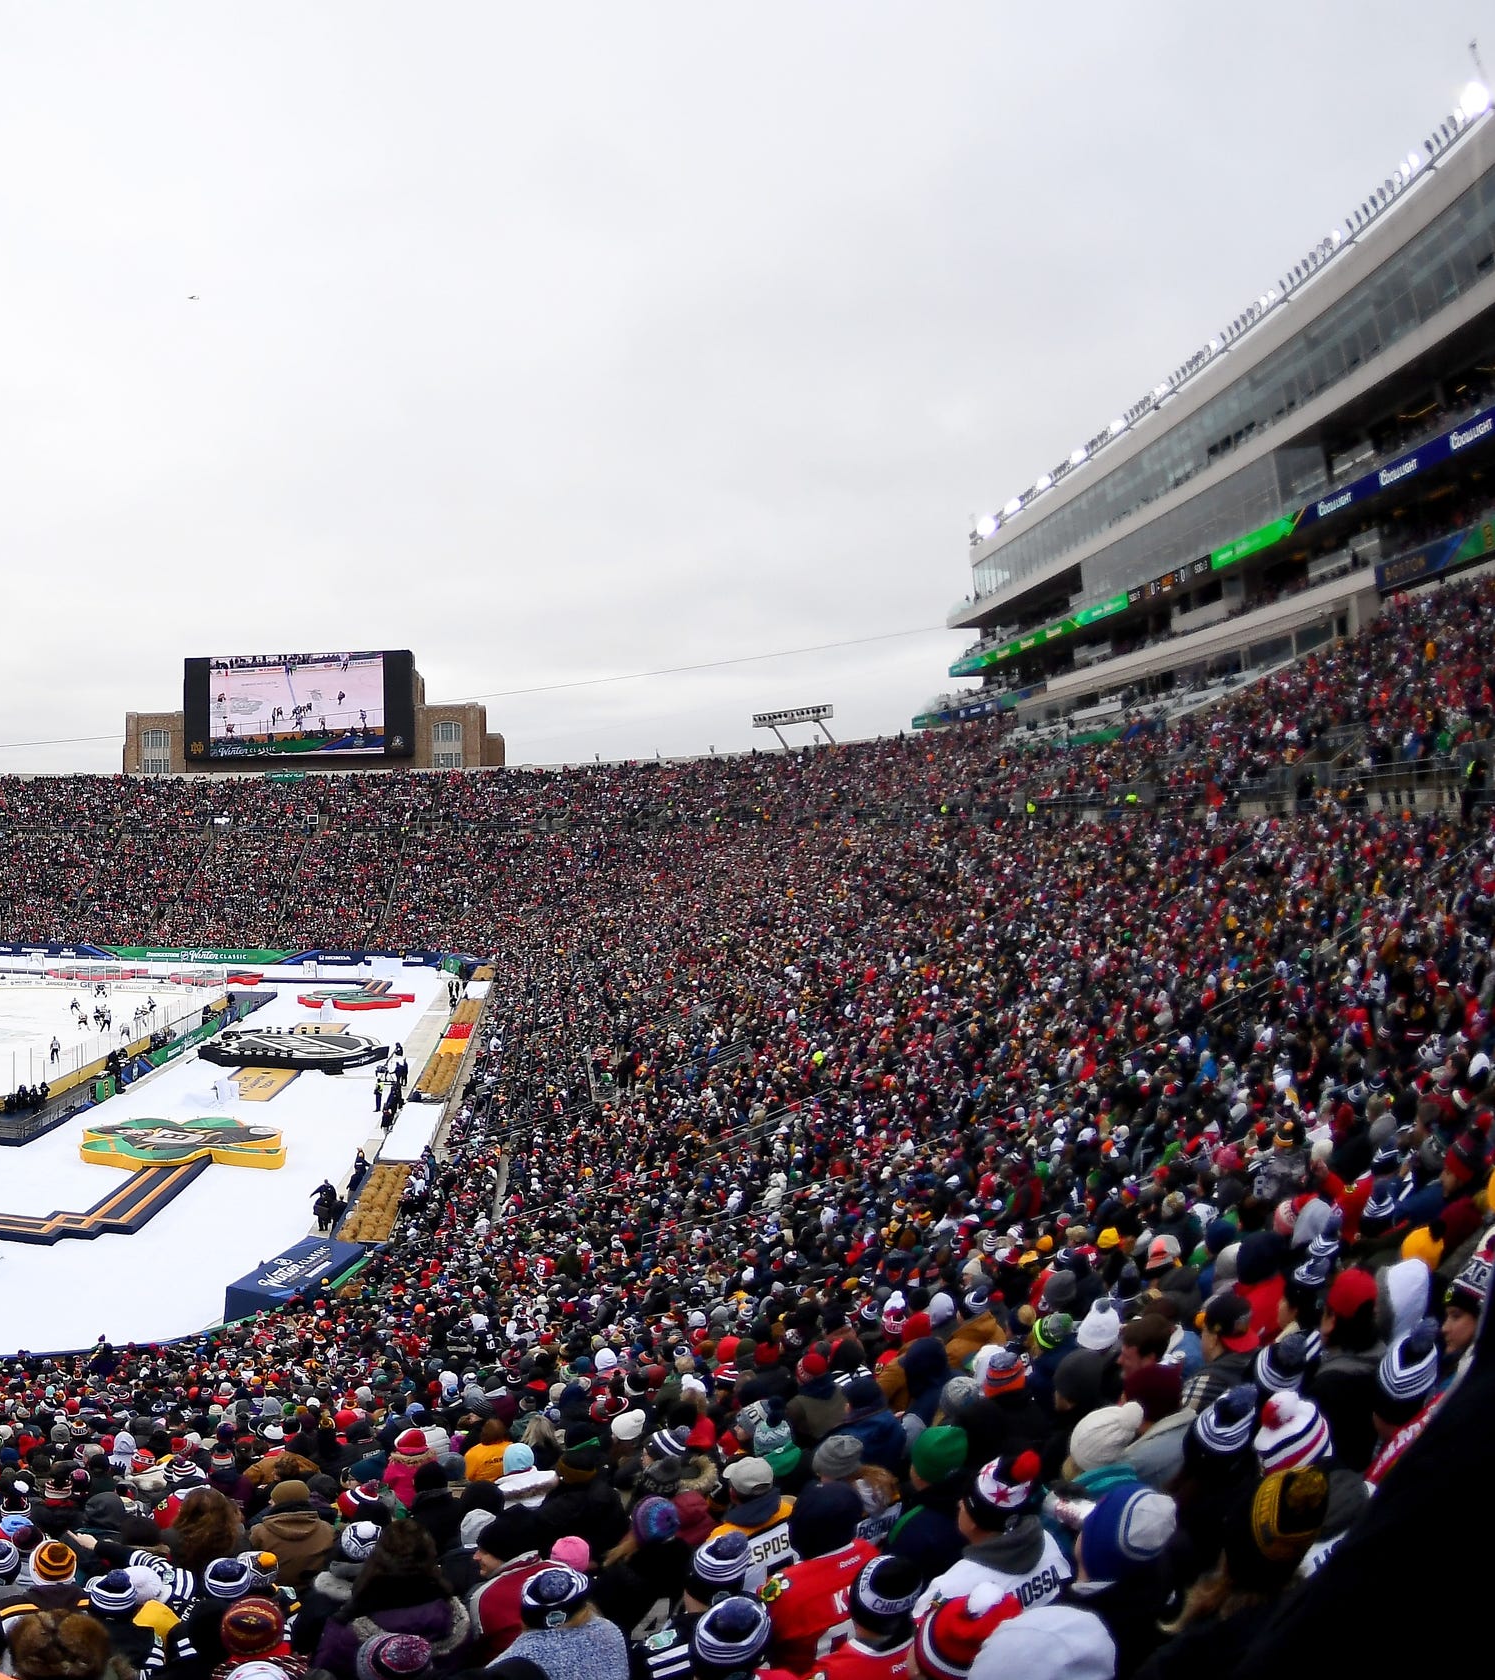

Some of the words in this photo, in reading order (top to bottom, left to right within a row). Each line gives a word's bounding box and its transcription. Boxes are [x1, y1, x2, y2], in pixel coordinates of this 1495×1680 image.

[1471, 418, 1493, 439] LIGHT
[1397, 458, 1418, 477] LIGHT
[1334, 492, 1352, 510] LIGHT
[218, 746, 249, 757] Winter
[249, 746, 276, 754] CLASSIC
[189, 949, 219, 962] Winter
[258, 1263, 300, 1288] Winter
[839, 1556, 861, 1569] Reebok
